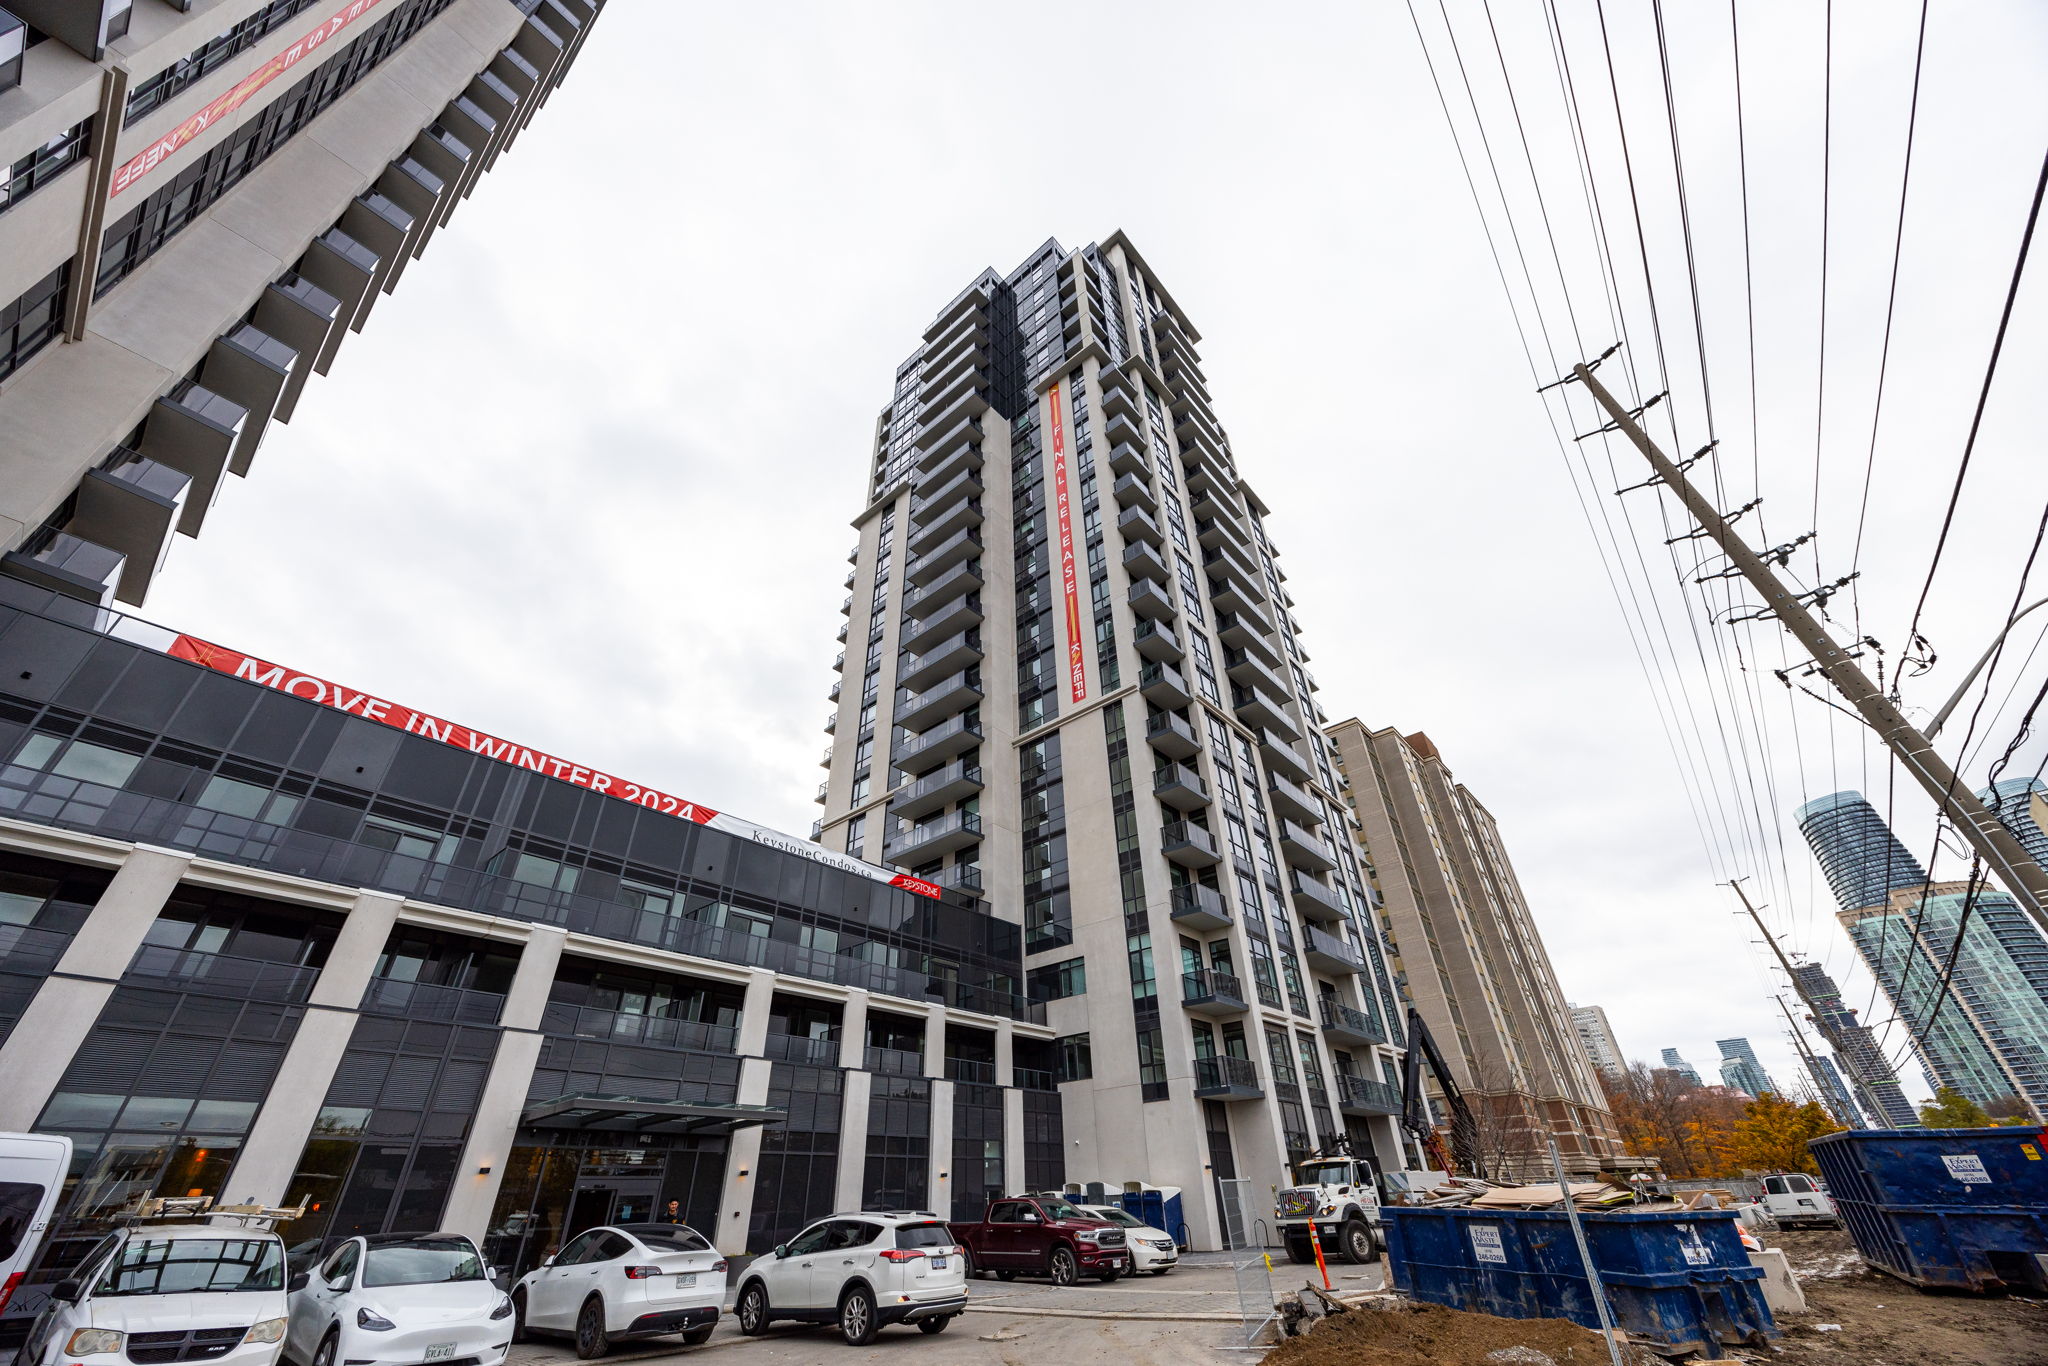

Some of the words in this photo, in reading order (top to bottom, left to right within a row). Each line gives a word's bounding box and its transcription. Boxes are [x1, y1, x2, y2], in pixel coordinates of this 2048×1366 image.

[1053, 424, 1065, 485] FINAL
[1058, 493, 1076, 593] RELEASE
[234, 657, 392, 719] MOVE
[404, 712, 454, 744] IN
[469, 731, 612, 794] WINTER
[624, 784, 694, 822] 2024
[753, 830, 872, 878] KeystoneCondos.ca
[903, 878, 938, 896] KEYSTONE
[1475, 1227, 1498, 1238] EXPERT
